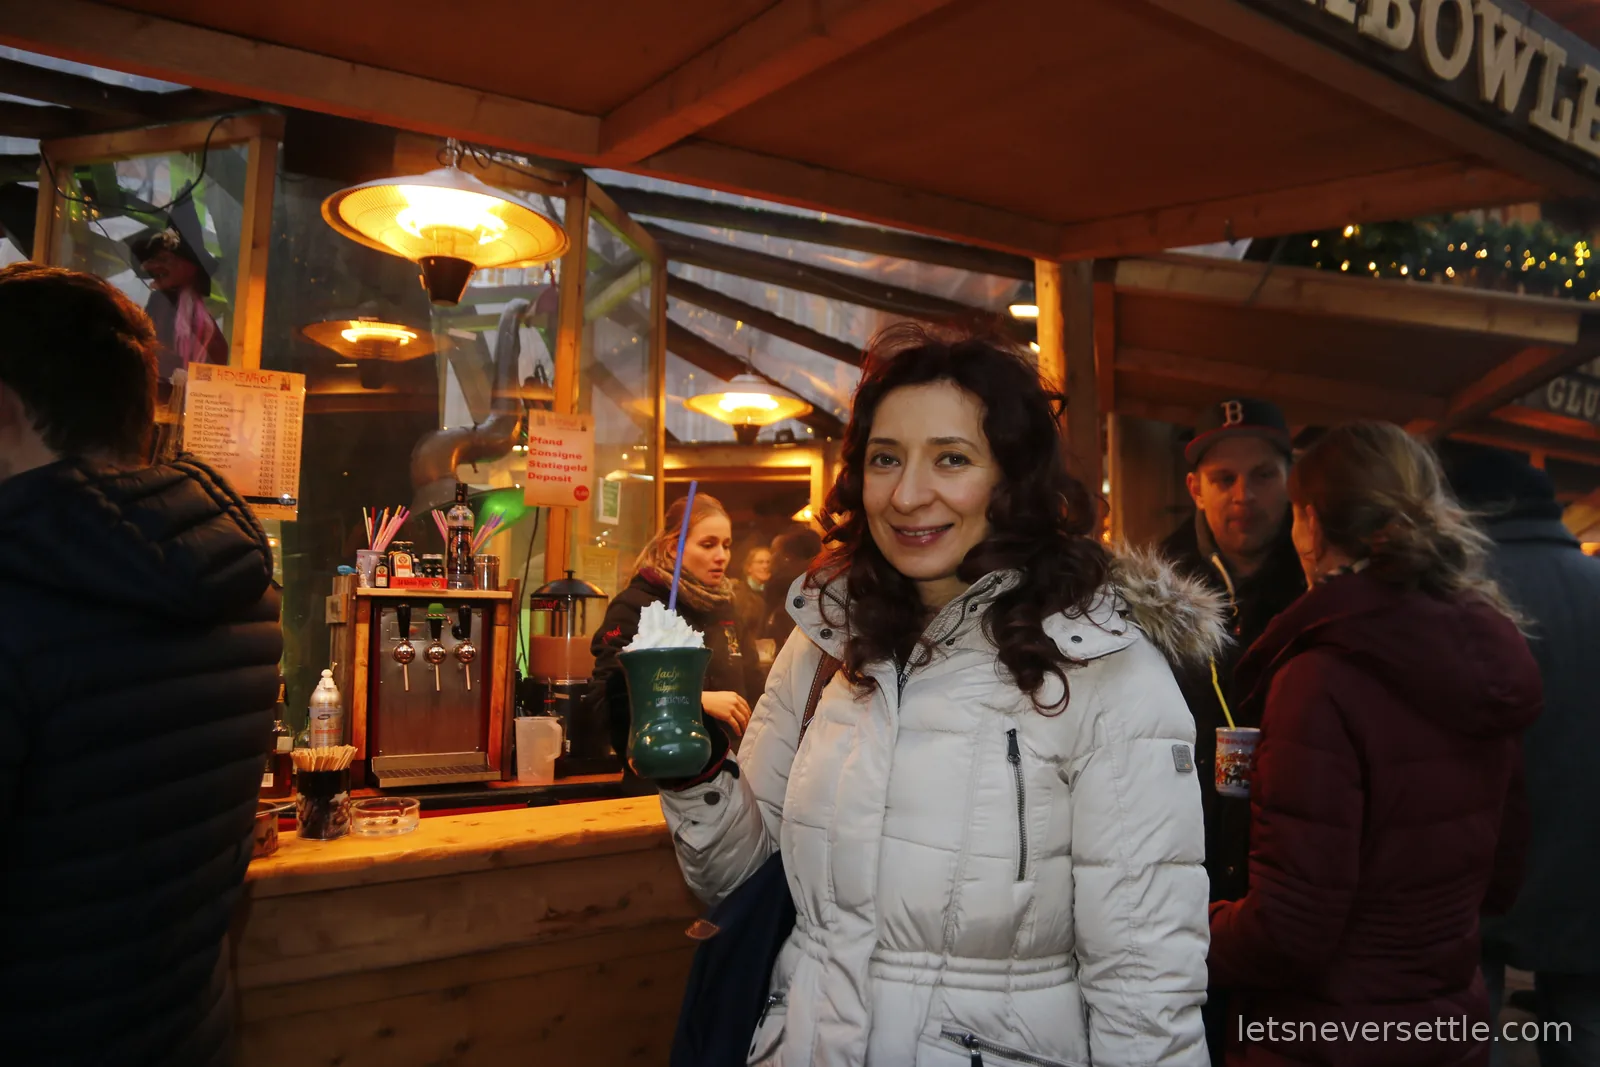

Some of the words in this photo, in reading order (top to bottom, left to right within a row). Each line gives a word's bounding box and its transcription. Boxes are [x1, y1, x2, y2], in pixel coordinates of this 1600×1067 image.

[1300, 0, 1600, 158] BOWLE
[1221, 400, 1243, 427] B
[530, 436, 563, 446] Pfand
[529, 448, 582, 460] Consigne
[528, 460, 588, 472] Statiegeld
[528, 472, 572, 483] Deposit
